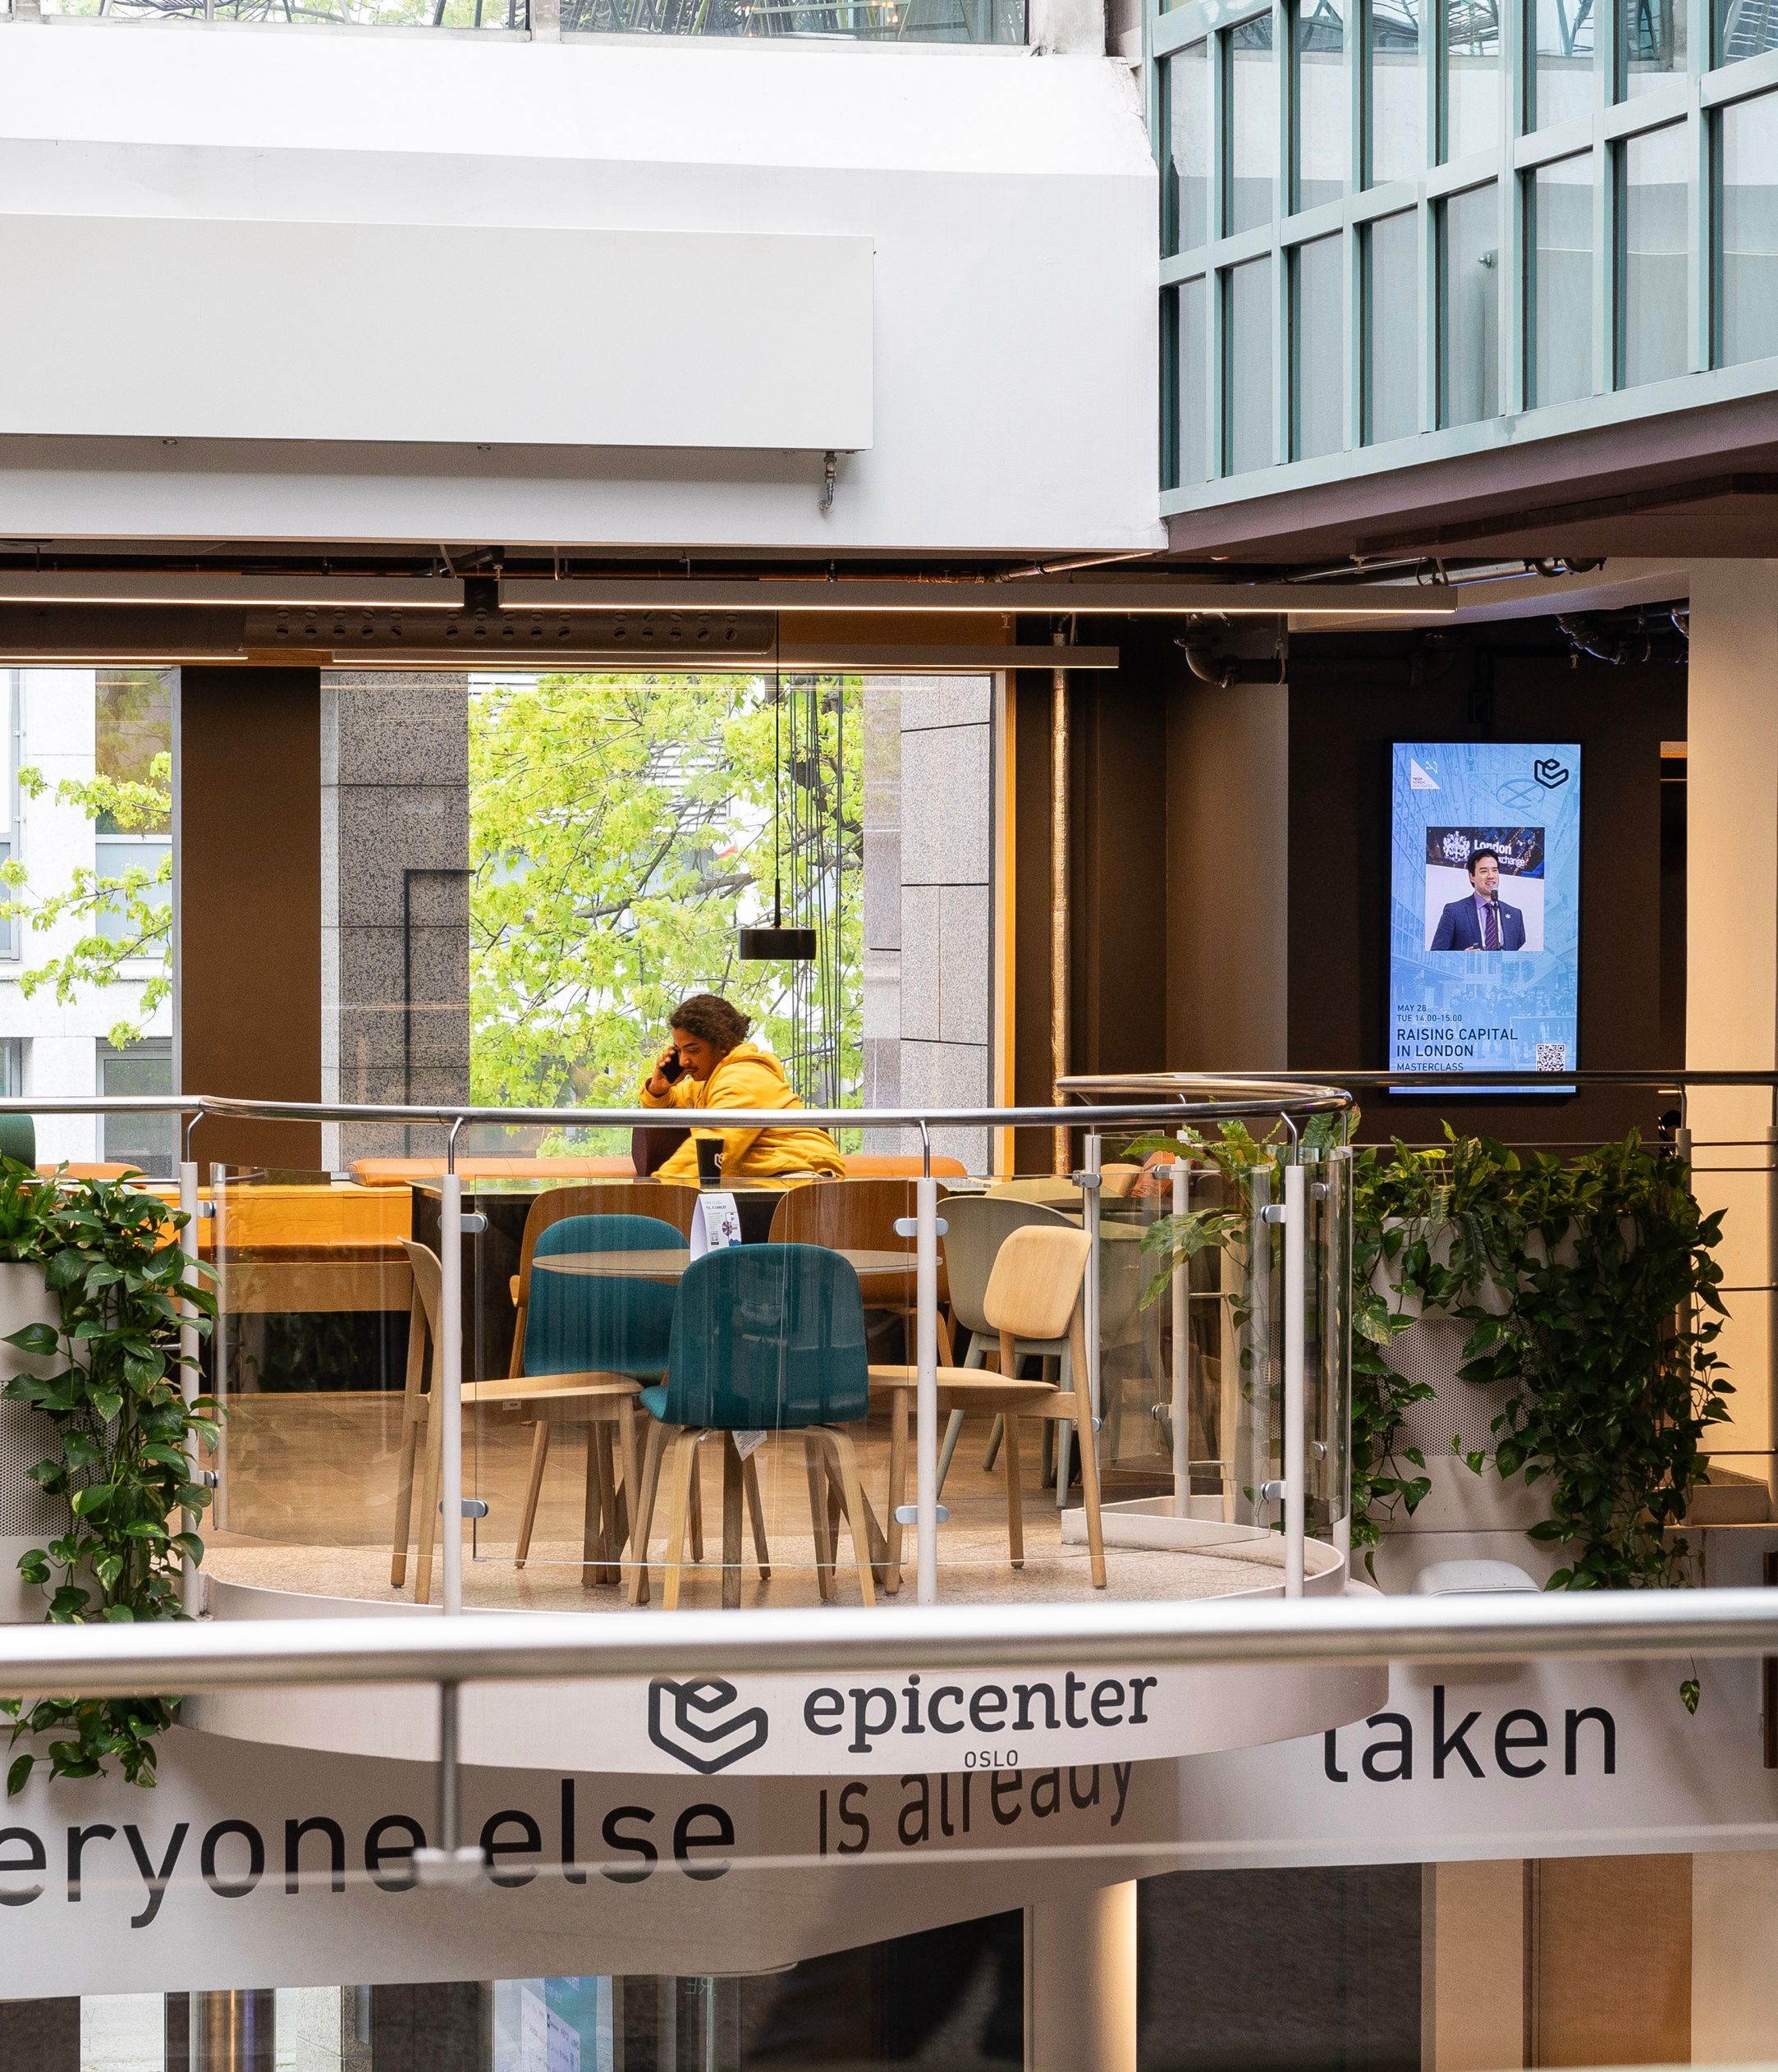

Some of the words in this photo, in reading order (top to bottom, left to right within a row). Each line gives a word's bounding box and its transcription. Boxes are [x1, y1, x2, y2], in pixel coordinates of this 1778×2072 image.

[1498, 855, 1525, 868] xchange
[1397, 1004, 1414, 1012] MAY
[1417, 1004, 1427, 1012] 28
[1415, 1014, 1463, 1022] 14.00-15.00
[1397, 1029, 1454, 1040] RAISING
[1459, 1028, 1518, 1040] CAPITAL
[1397, 1045, 1410, 1057] IN
[1415, 1045, 1473, 1057] LONDON
[1397, 1063, 1464, 1071] MASTERCLASS
[804, 1671, 1157, 1753] epicenter
[964, 1749, 1019, 1768] OSLO
[820, 1781, 870, 1858] is
[479, 1778, 735, 1888] else
